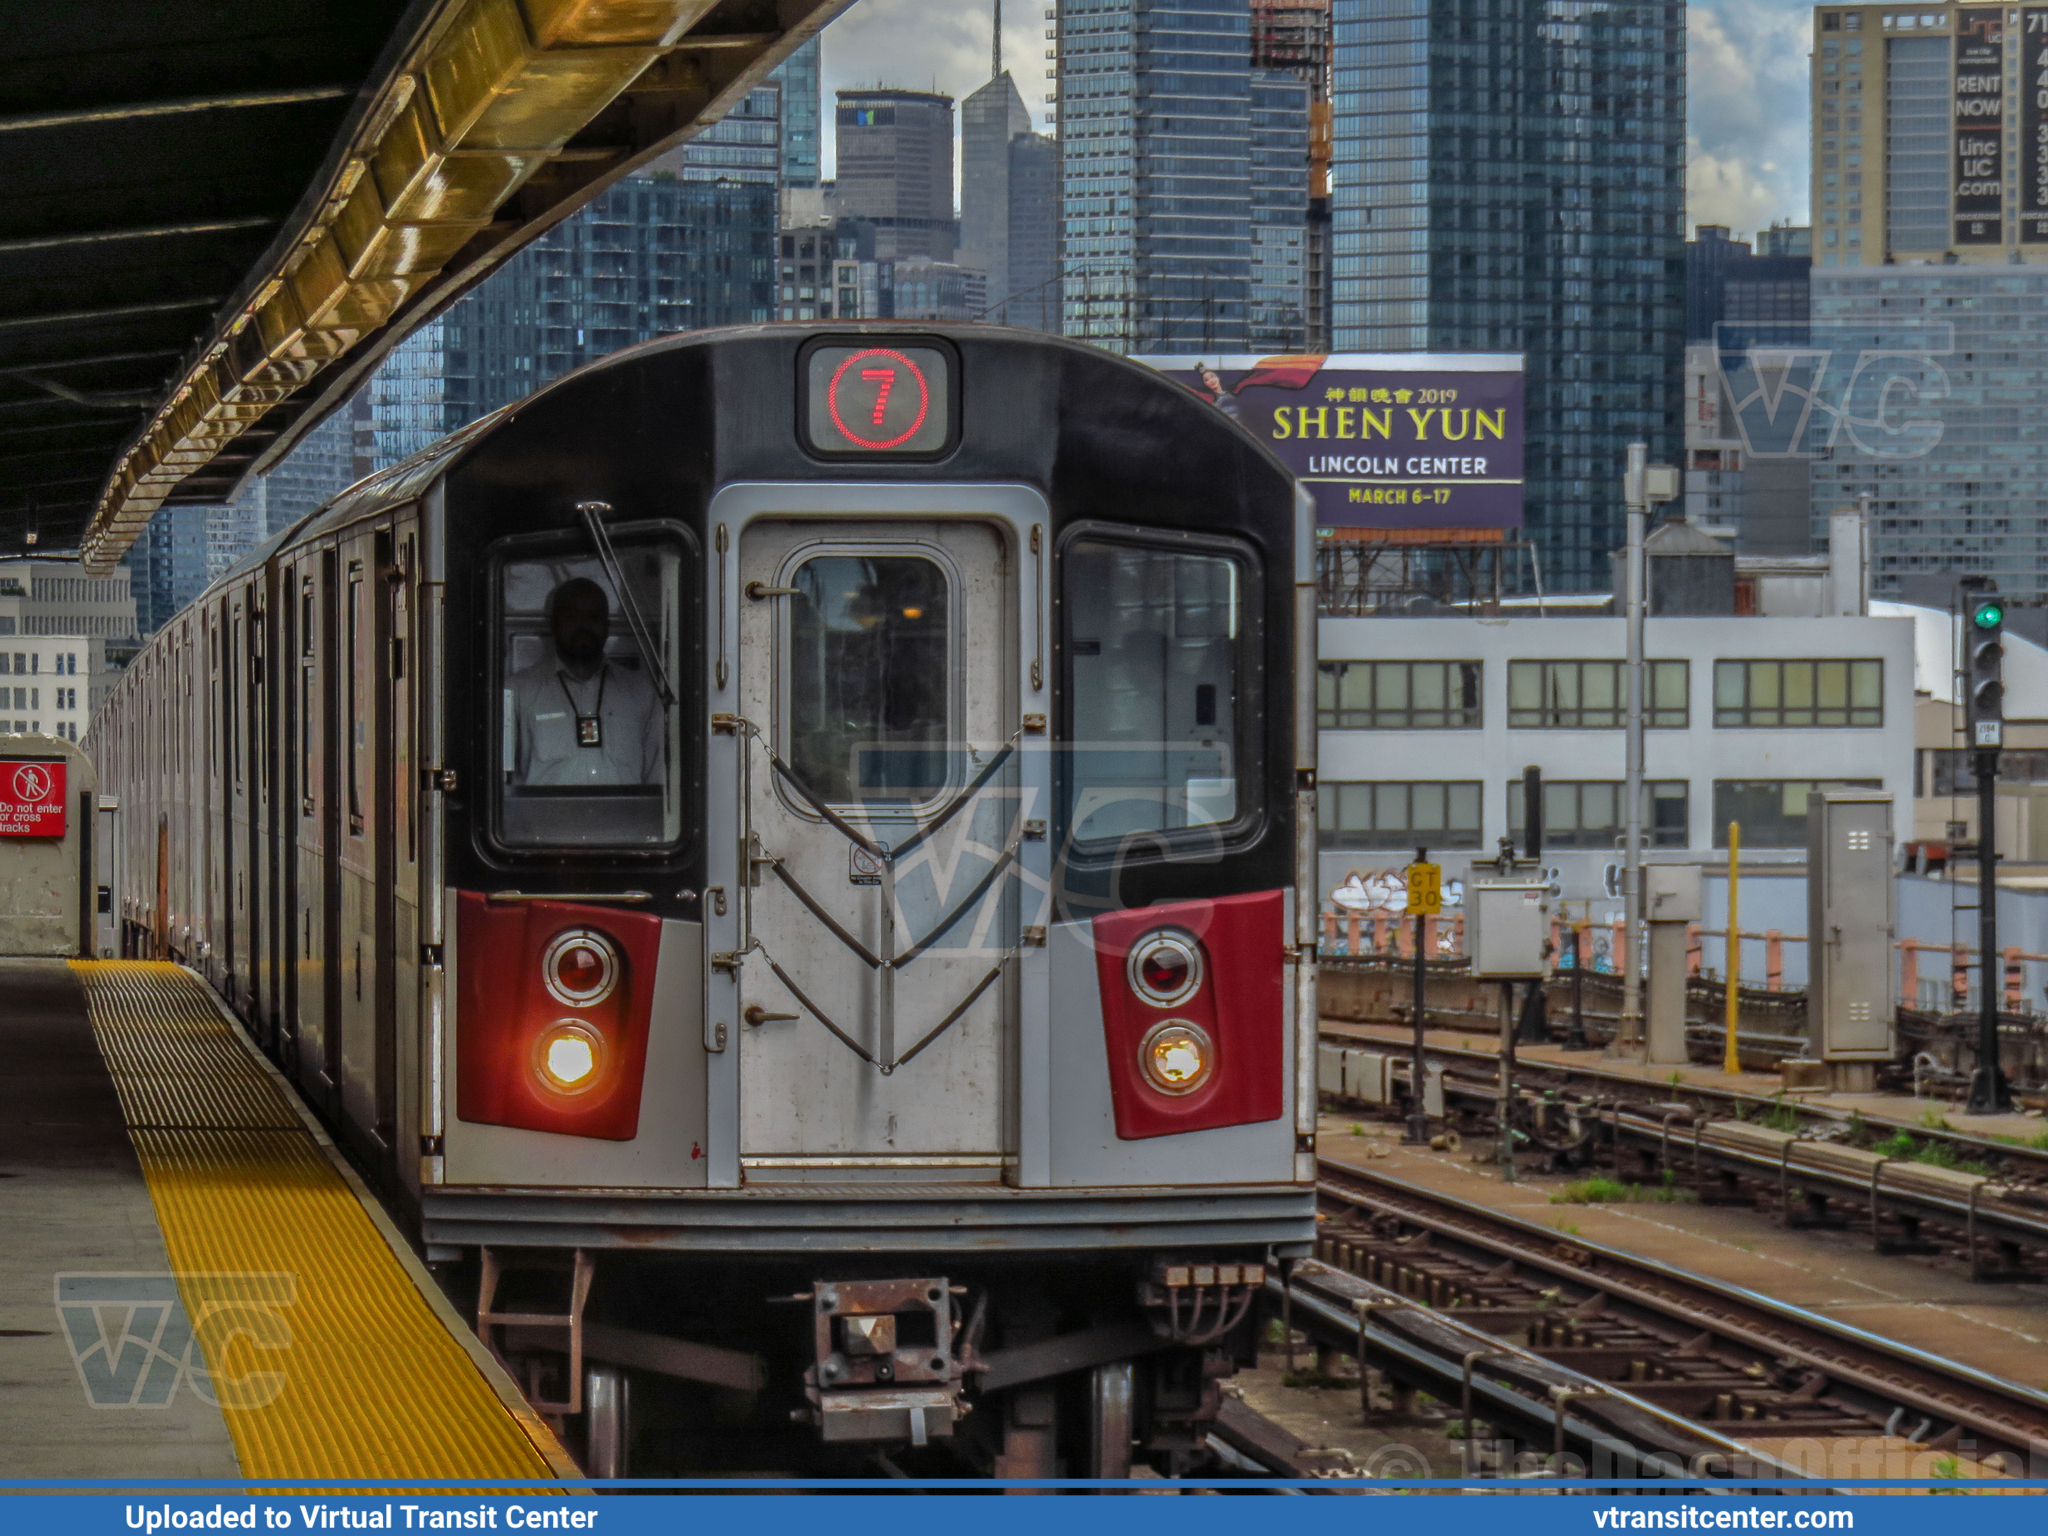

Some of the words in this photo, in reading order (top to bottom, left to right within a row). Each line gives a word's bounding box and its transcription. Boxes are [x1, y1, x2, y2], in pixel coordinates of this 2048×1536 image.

[1957, 76, 2000, 93] RENT
[1956, 100, 2000, 116] NOW
[1959, 138, 1997, 156] Linc
[1963, 159, 1993, 177] LIC
[861, 369, 895, 425] 7
[1417, 388, 1458, 404] 2019
[1272, 406, 1392, 440] SHEN
[1407, 406, 1506, 440] YUN
[1309, 456, 1399, 475] LINCOLN
[1406, 457, 1487, 475] CENTER
[1349, 488, 1408, 505] MARCH
[0, 802, 13, 813] Do
[17, 803, 33, 813] not
[37, 803, 63, 814] enter
[0, 813, 11, 822] or
[13, 813, 41, 822] cross
[0, 822, 30, 833] tracks
[1410, 872, 1437, 888] GT
[1410, 890, 1438, 907] 30
